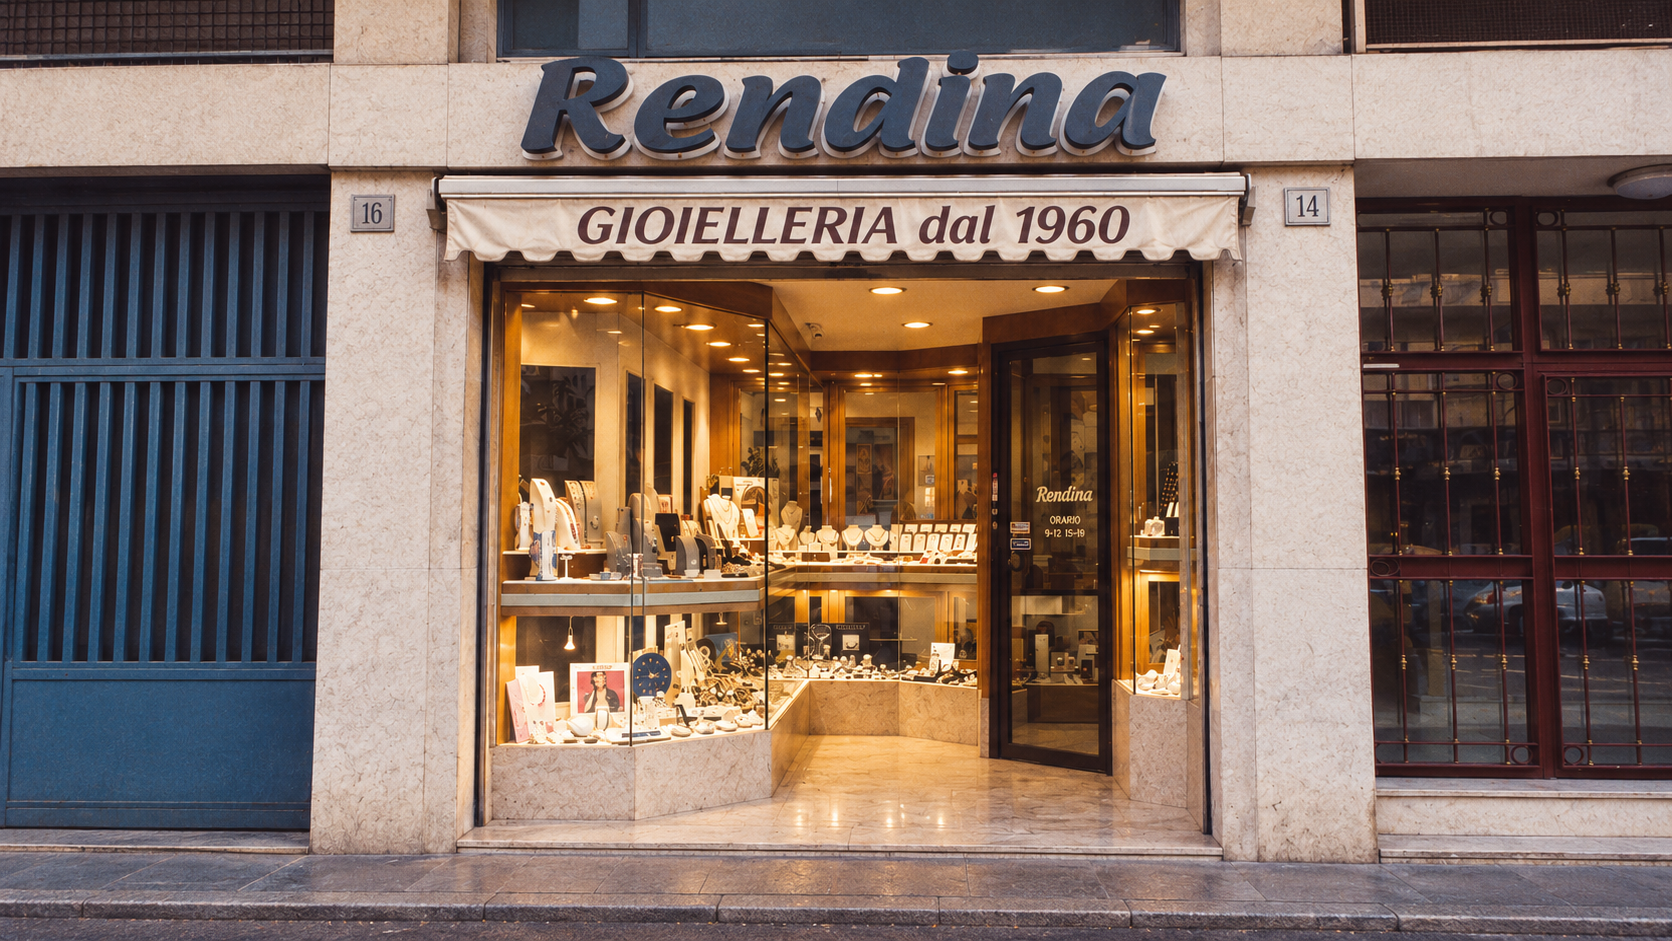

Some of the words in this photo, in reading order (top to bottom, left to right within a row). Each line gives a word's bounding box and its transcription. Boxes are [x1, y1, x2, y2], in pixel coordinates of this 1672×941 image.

[520, 51, 1167, 159] Rendina
[362, 202, 382, 224] 16
[1296, 194, 1319, 217] 14
[577, 205, 898, 246] GIOIELLERIA
[918, 205, 996, 245] dal
[1015, 205, 1131, 245] 1960
[1036, 485, 1093, 502] Rendina
[1049, 515, 1081, 525] ORARIO
[1044, 528, 1062, 538] 9-12
